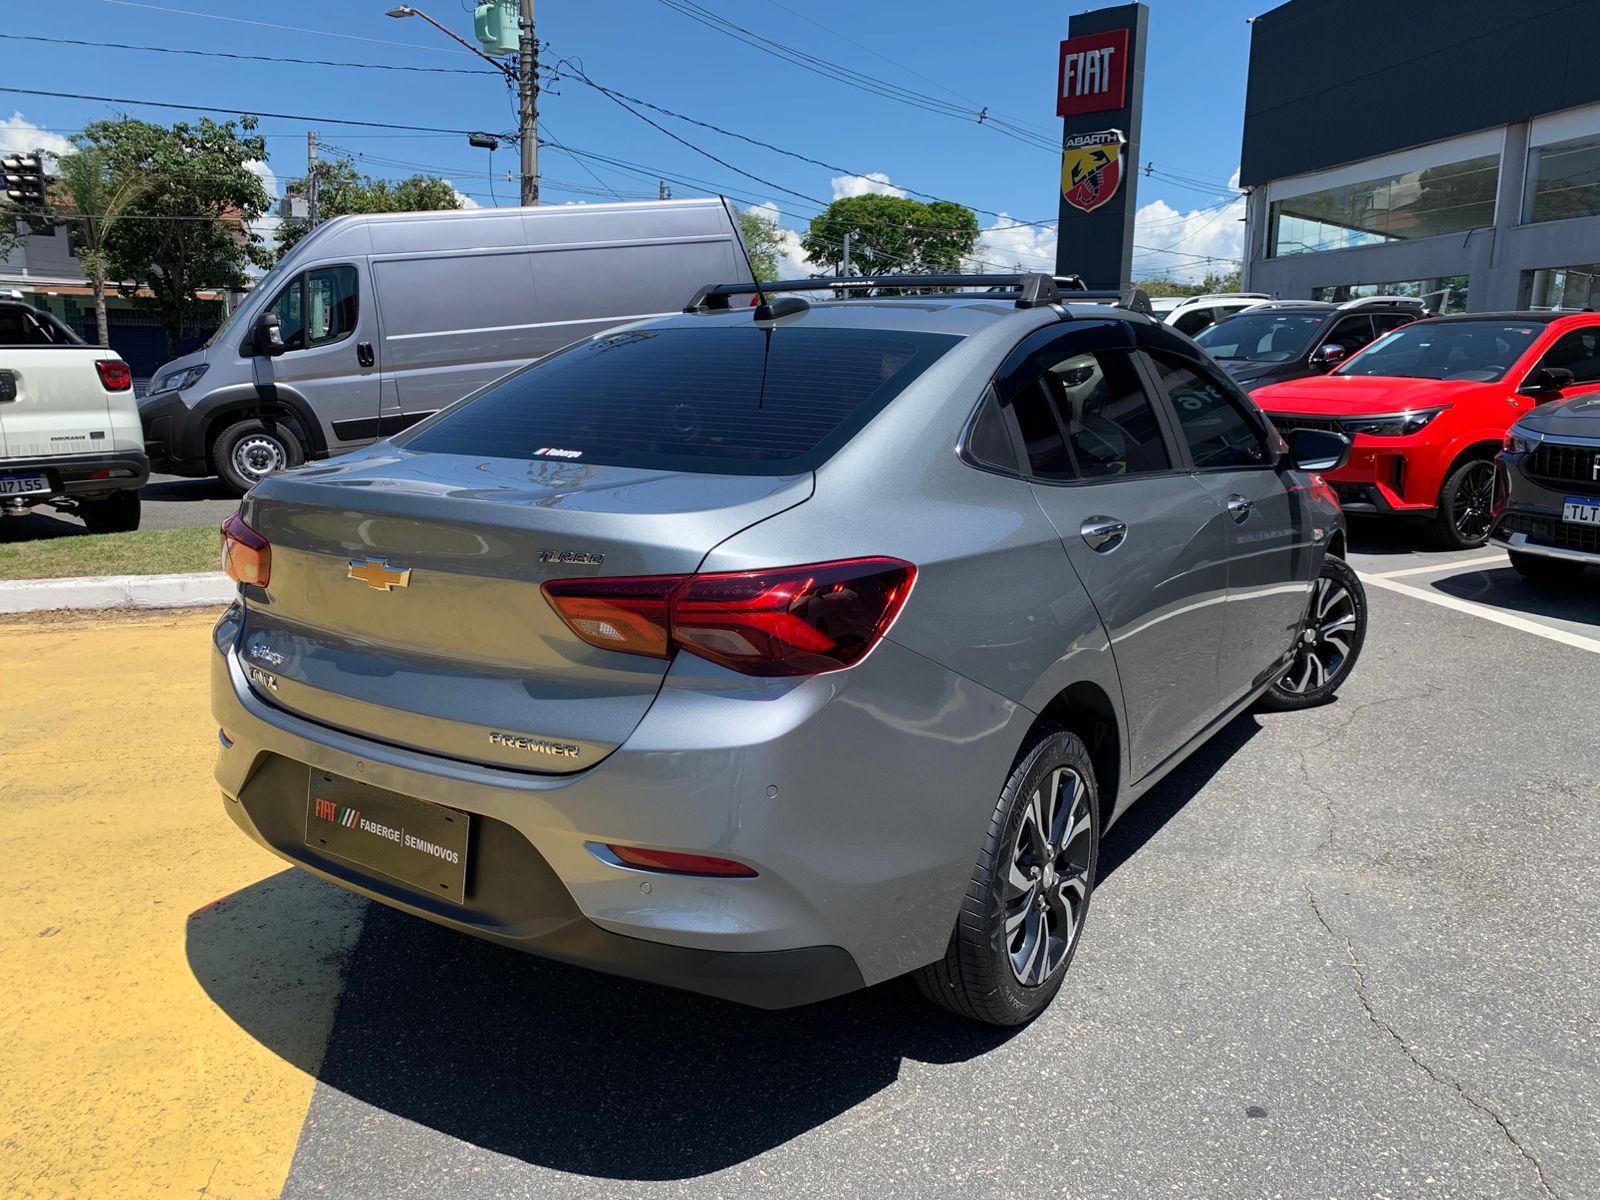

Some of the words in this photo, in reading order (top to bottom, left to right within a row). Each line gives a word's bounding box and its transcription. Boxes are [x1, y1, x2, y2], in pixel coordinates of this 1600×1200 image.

[1062, 47, 1115, 98] FIAT
[1066, 134, 1118, 147] ABARTH
[1572, 505, 1600, 523] TLT
[537, 550, 605, 565] TURBO
[488, 731, 580, 758] PREMIER
[315, 797, 337, 822] FIAT
[360, 818, 401, 843] FABERGE
[404, 833, 459, 865] SEMINOVOS
